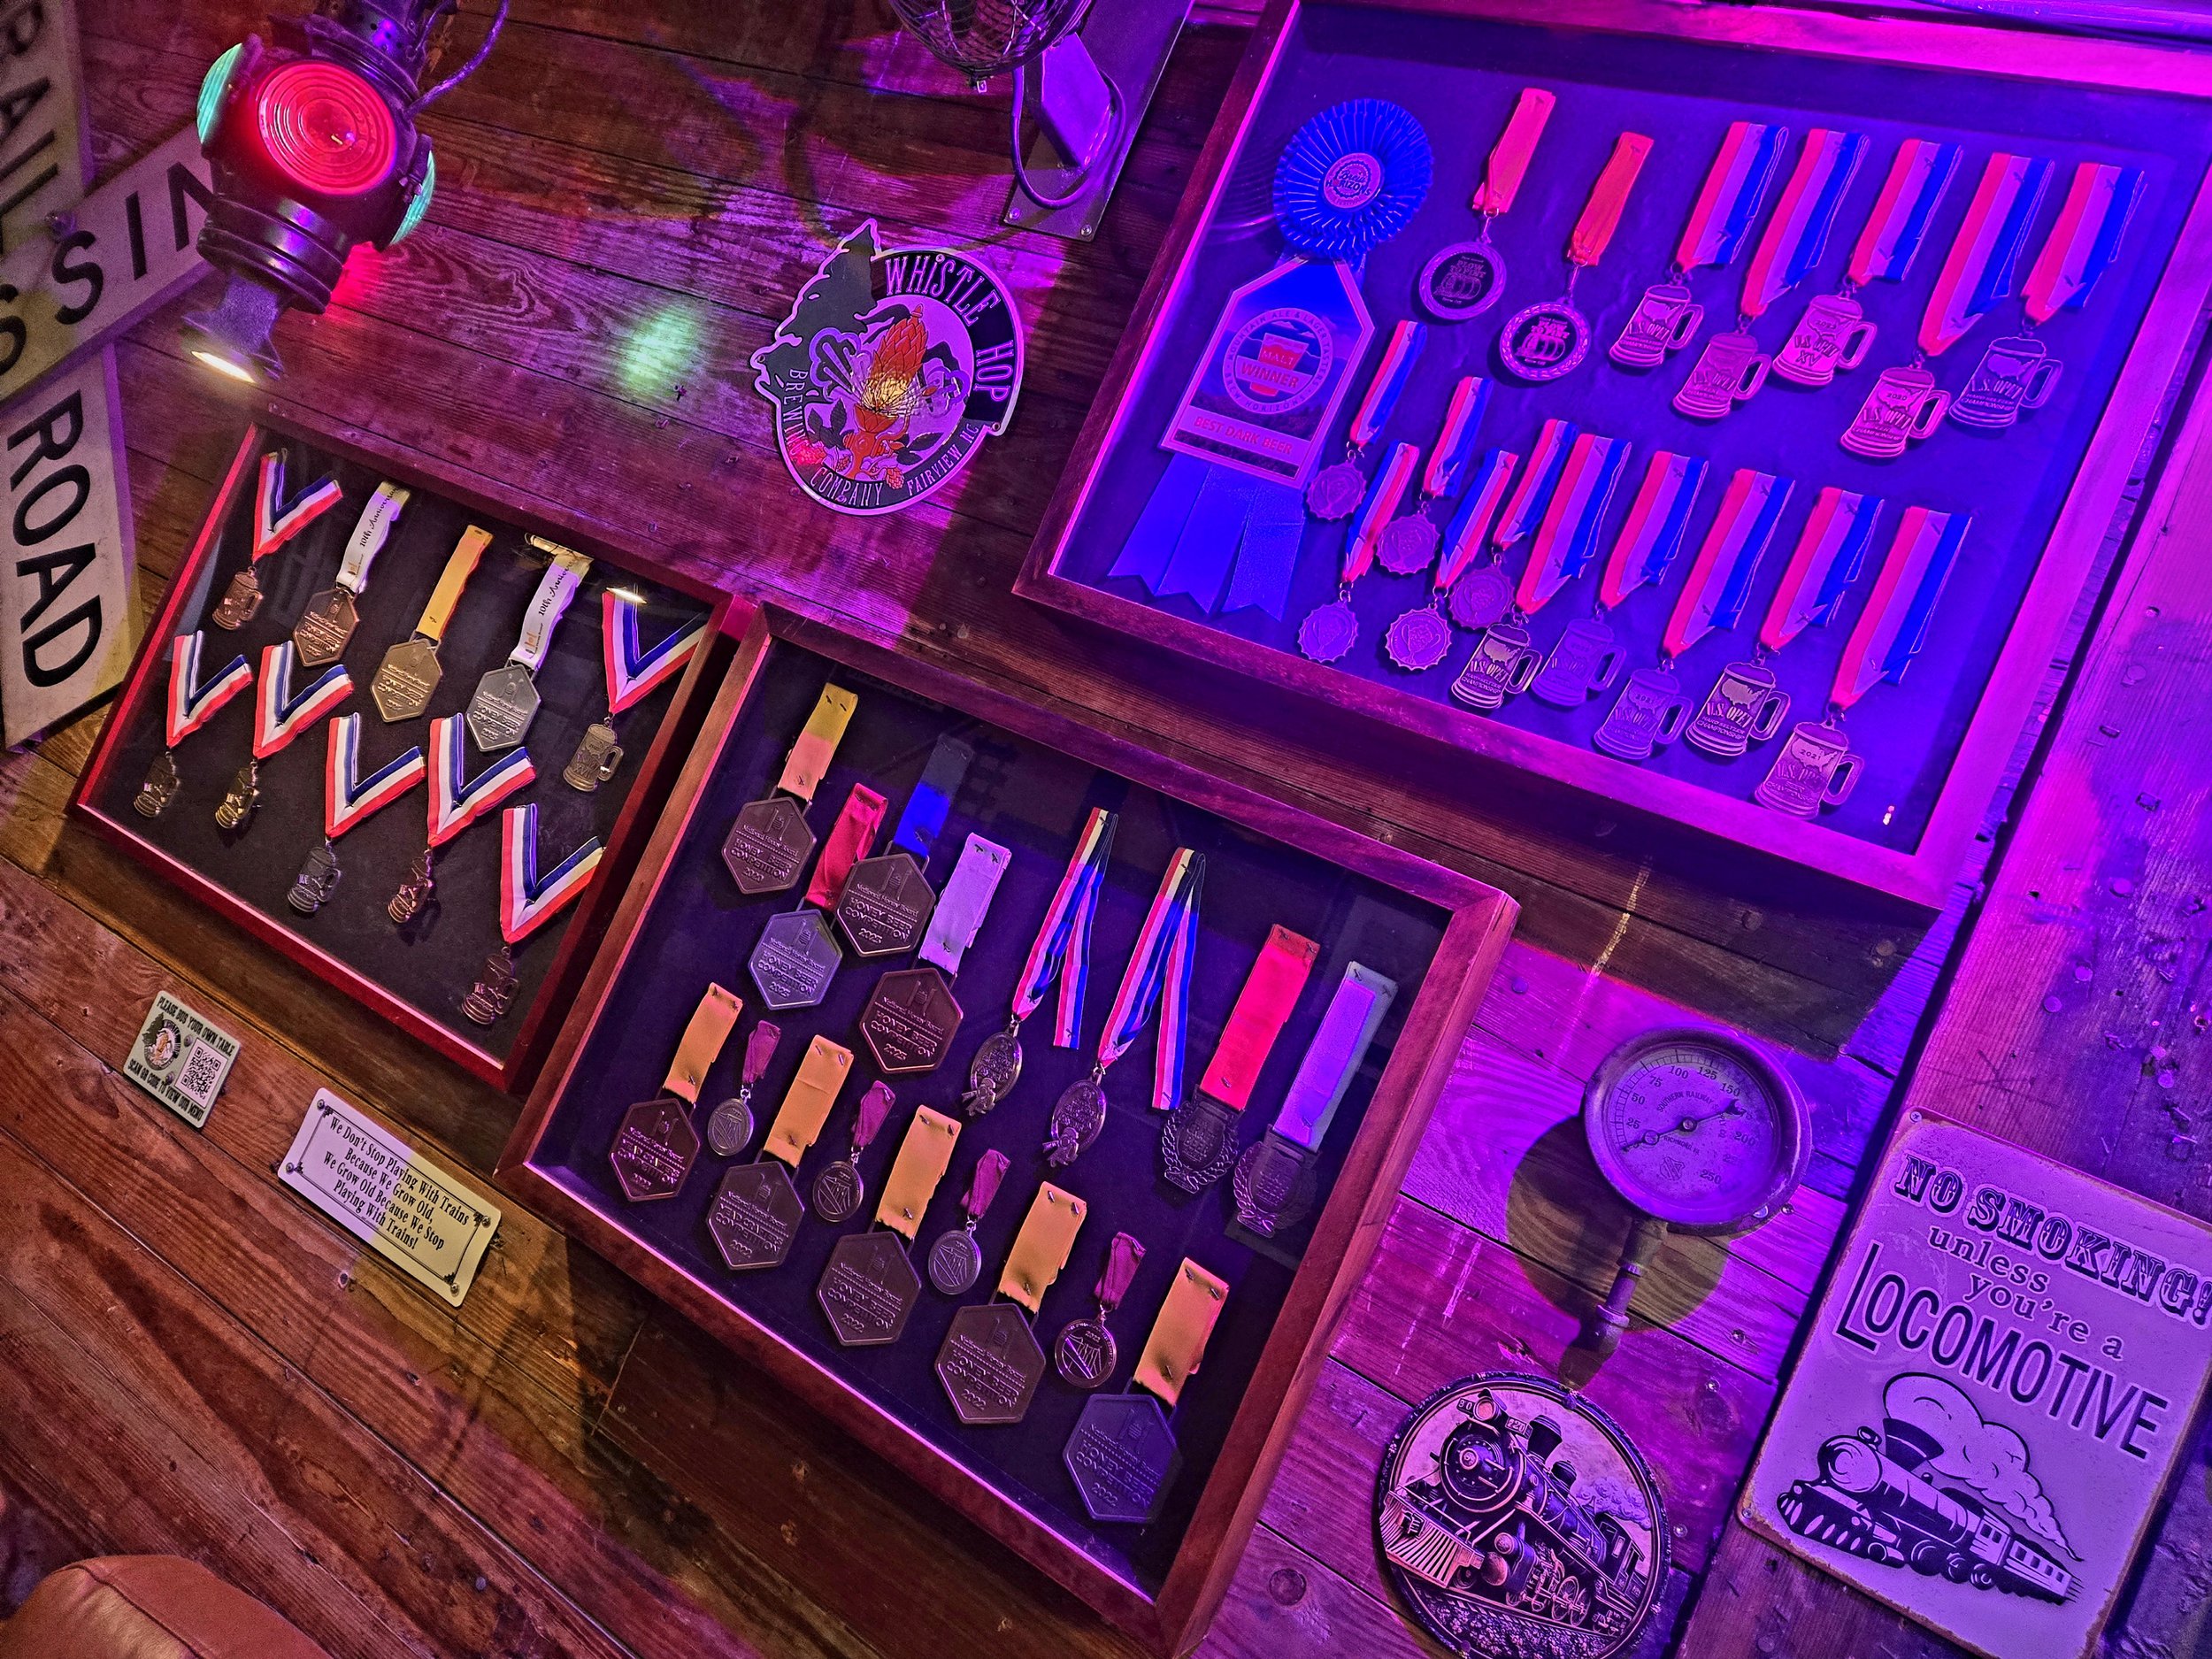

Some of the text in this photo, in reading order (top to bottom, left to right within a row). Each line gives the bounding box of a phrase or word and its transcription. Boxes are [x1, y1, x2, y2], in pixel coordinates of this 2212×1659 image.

[973, 340, 1015, 403] HOP
[1240, 361, 1301, 389] WINNER
[1194, 416, 1293, 455] BEST DARK BEER
[809, 467, 884, 507] COMPANY
[906, 443, 964, 496] FAIRVIEW
[8, 389, 103, 689] ROAD
[1799, 749, 1823, 761] 2021
[845, 906, 910, 943] COMPETITION
[849, 896, 913, 934] HONEY BEER
[156, 996, 178, 1017] PLEASE
[186, 1014, 204, 1035] YOUR
[202, 1026, 219, 1045] OWN
[216, 1038, 235, 1056] TABLE
[1648, 1075, 1663, 1088] 75
[1668, 1065, 1689, 1080] 100
[1696, 1066, 1718, 1081] 125
[1719, 1082, 1741, 1097] 150
[188, 1104, 204, 1121] MENU
[1631, 1092, 1646, 1106] 50
[1655, 1090, 1715, 1113] SOUTHERN RAILWAY
[1626, 1117, 1641, 1130] 25
[1733, 1131, 1756, 1148] 200
[1663, 1135, 1693, 1152] RICHMOND
[329, 1116, 470, 1226] We Don't Stop Playing With Trains
[344, 1146, 434, 1225] Because We Grow Old,
[1699, 1168, 1722, 1186] 250
[323, 1150, 336, 1170] We
[336, 1161, 360, 1186] Grow
[358, 1178, 377, 1198] Old
[374, 1189, 409, 1224] Because
[410, 1214, 425, 1234] We
[424, 1225, 445, 1251] Stop
[333, 1179, 367, 1215] Playing
[365, 1202, 387, 1227] With
[386, 1217, 419, 1250] Trains!
[1894, 1152, 2212, 1326] NO SMOKING!
[1928, 1225, 2051, 1296] unless
[1962, 1270, 2124, 1361] you're a
[1835, 1241, 2170, 1461] LOCOMOTIVE
[1507, 1417, 1526, 1432] 220
[1090, 1481, 1119, 1508] 2022
